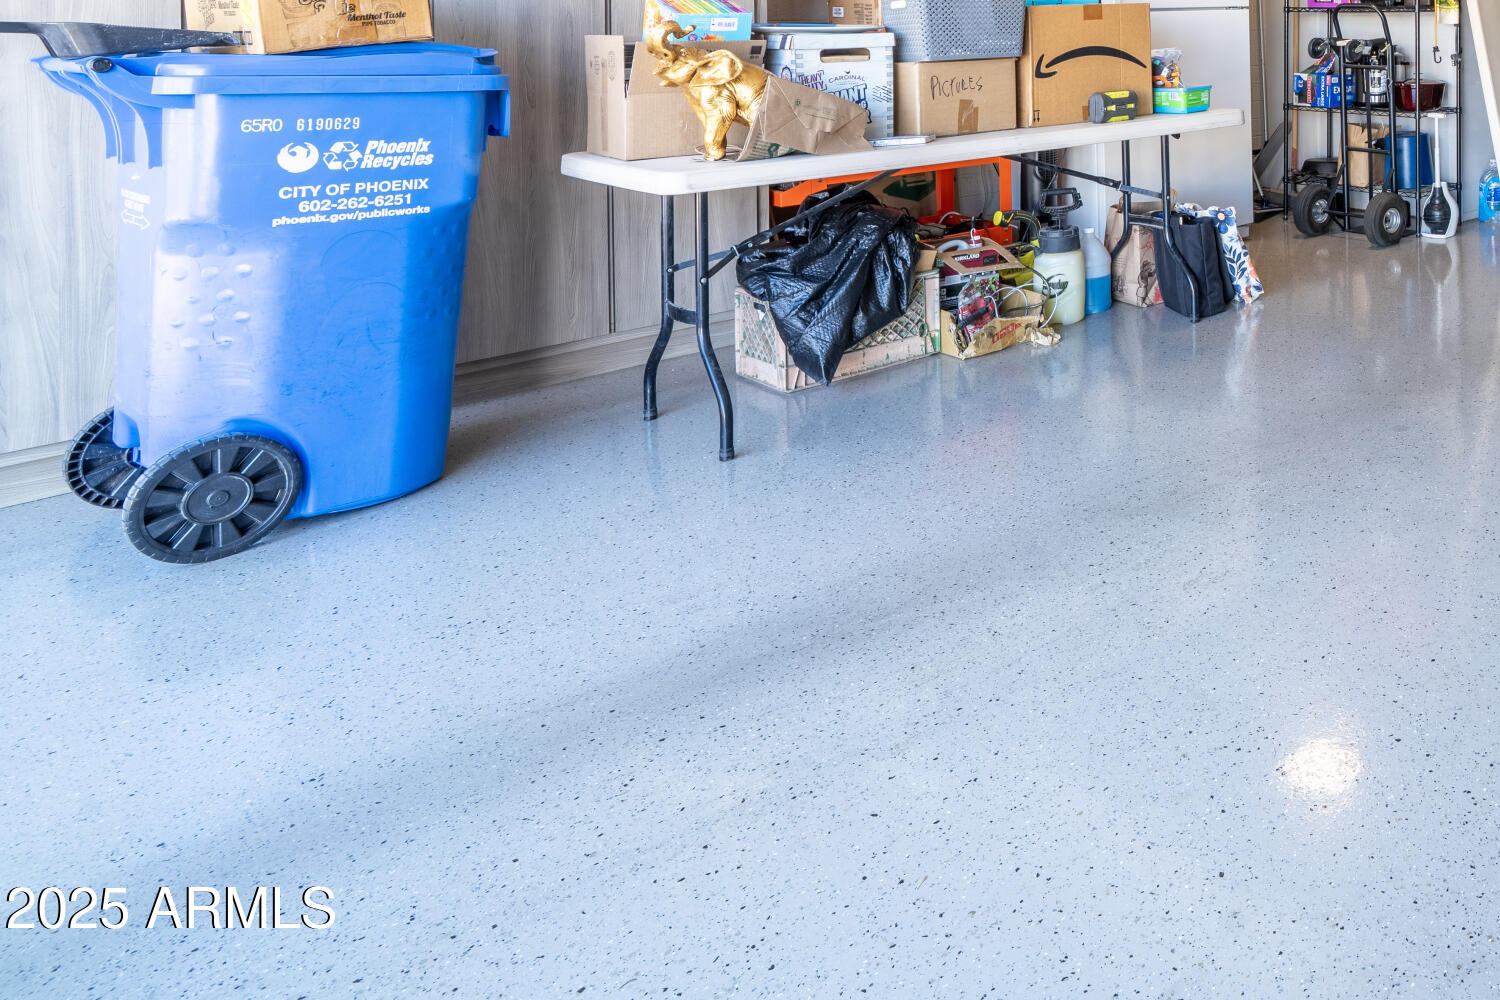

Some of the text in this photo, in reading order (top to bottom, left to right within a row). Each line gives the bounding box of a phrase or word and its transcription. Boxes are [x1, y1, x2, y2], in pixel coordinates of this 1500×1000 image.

[347, 11, 407, 22] Menthol Taste
[801, 72, 822, 86] HEAVY
[828, 74, 866, 84] CARDINAL
[930, 75, 983, 100] PICTURES
[296, 117, 361, 132] 6190629
[365, 138, 431, 155] Phoenix
[360, 152, 434, 170] Recycles
[278, 178, 429, 199] CITY OF PHOENIX
[298, 193, 412, 213] 602-262-6251
[271, 205, 431, 227] phoenix.gov/publicworks
[954, 253, 980, 262] KIRKLAND
